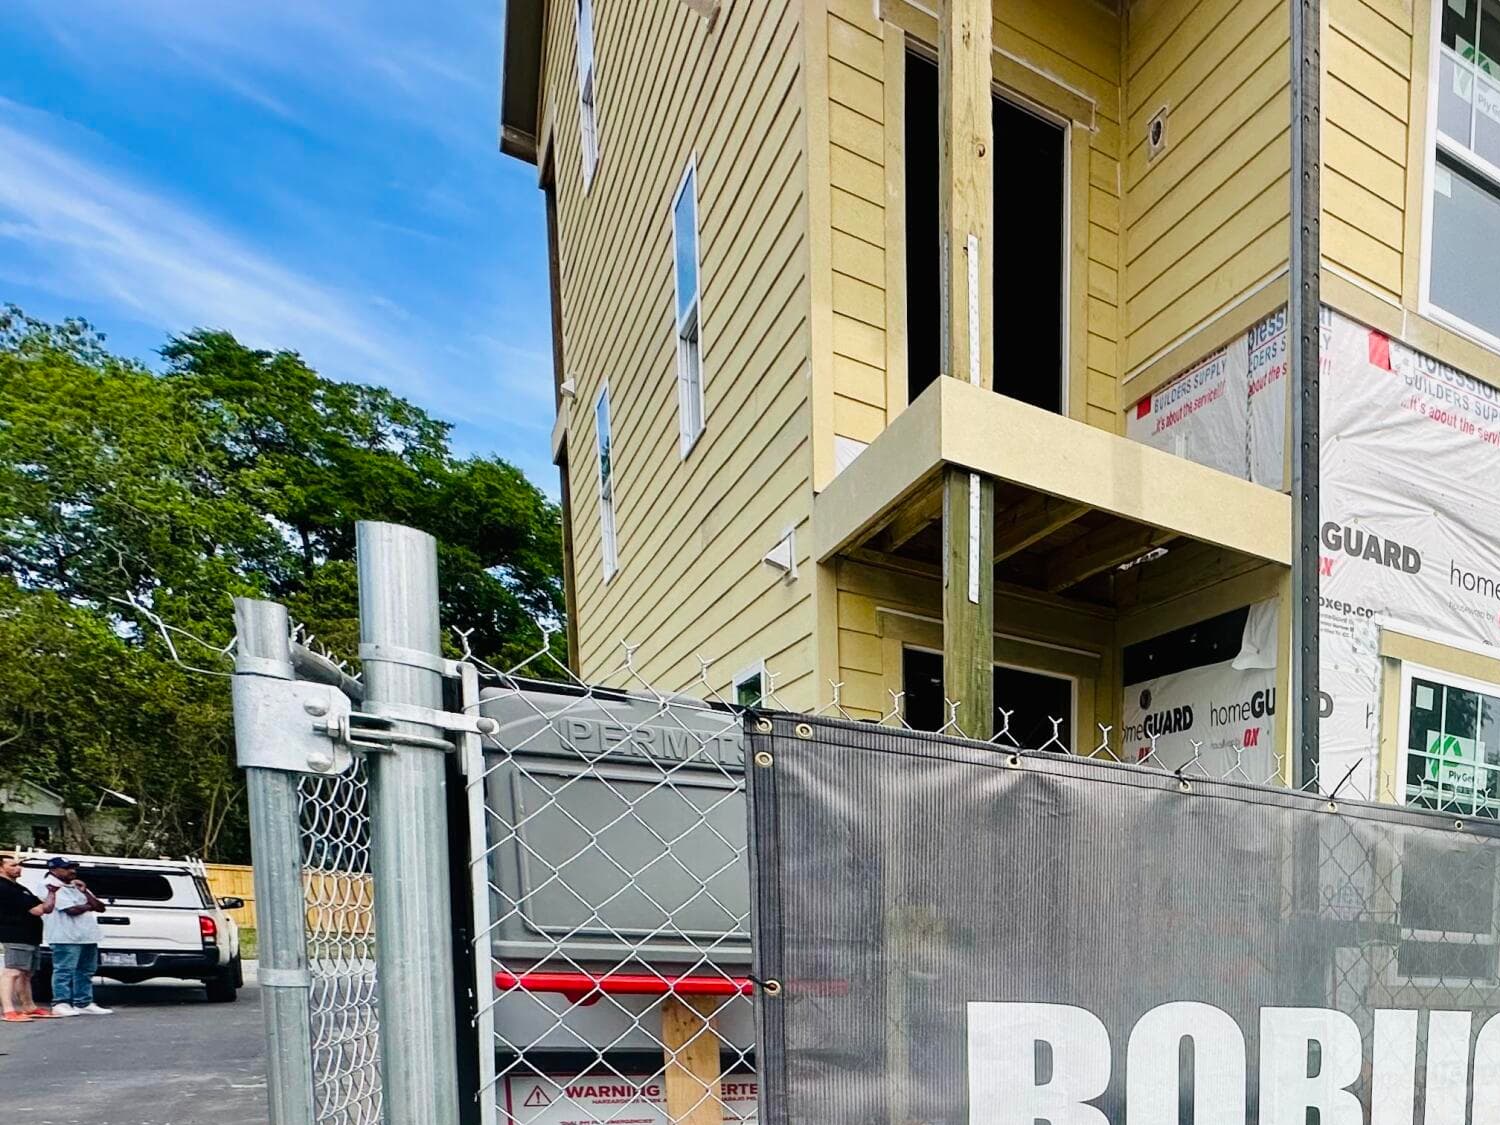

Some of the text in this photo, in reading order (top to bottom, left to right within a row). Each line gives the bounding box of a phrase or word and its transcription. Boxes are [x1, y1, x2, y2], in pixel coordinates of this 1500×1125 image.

[1428, 406, 1457, 427] about
[1459, 416, 1476, 435] the
[1243, 728, 1260, 747] OX
[564, 1085, 660, 1098] WARNING
